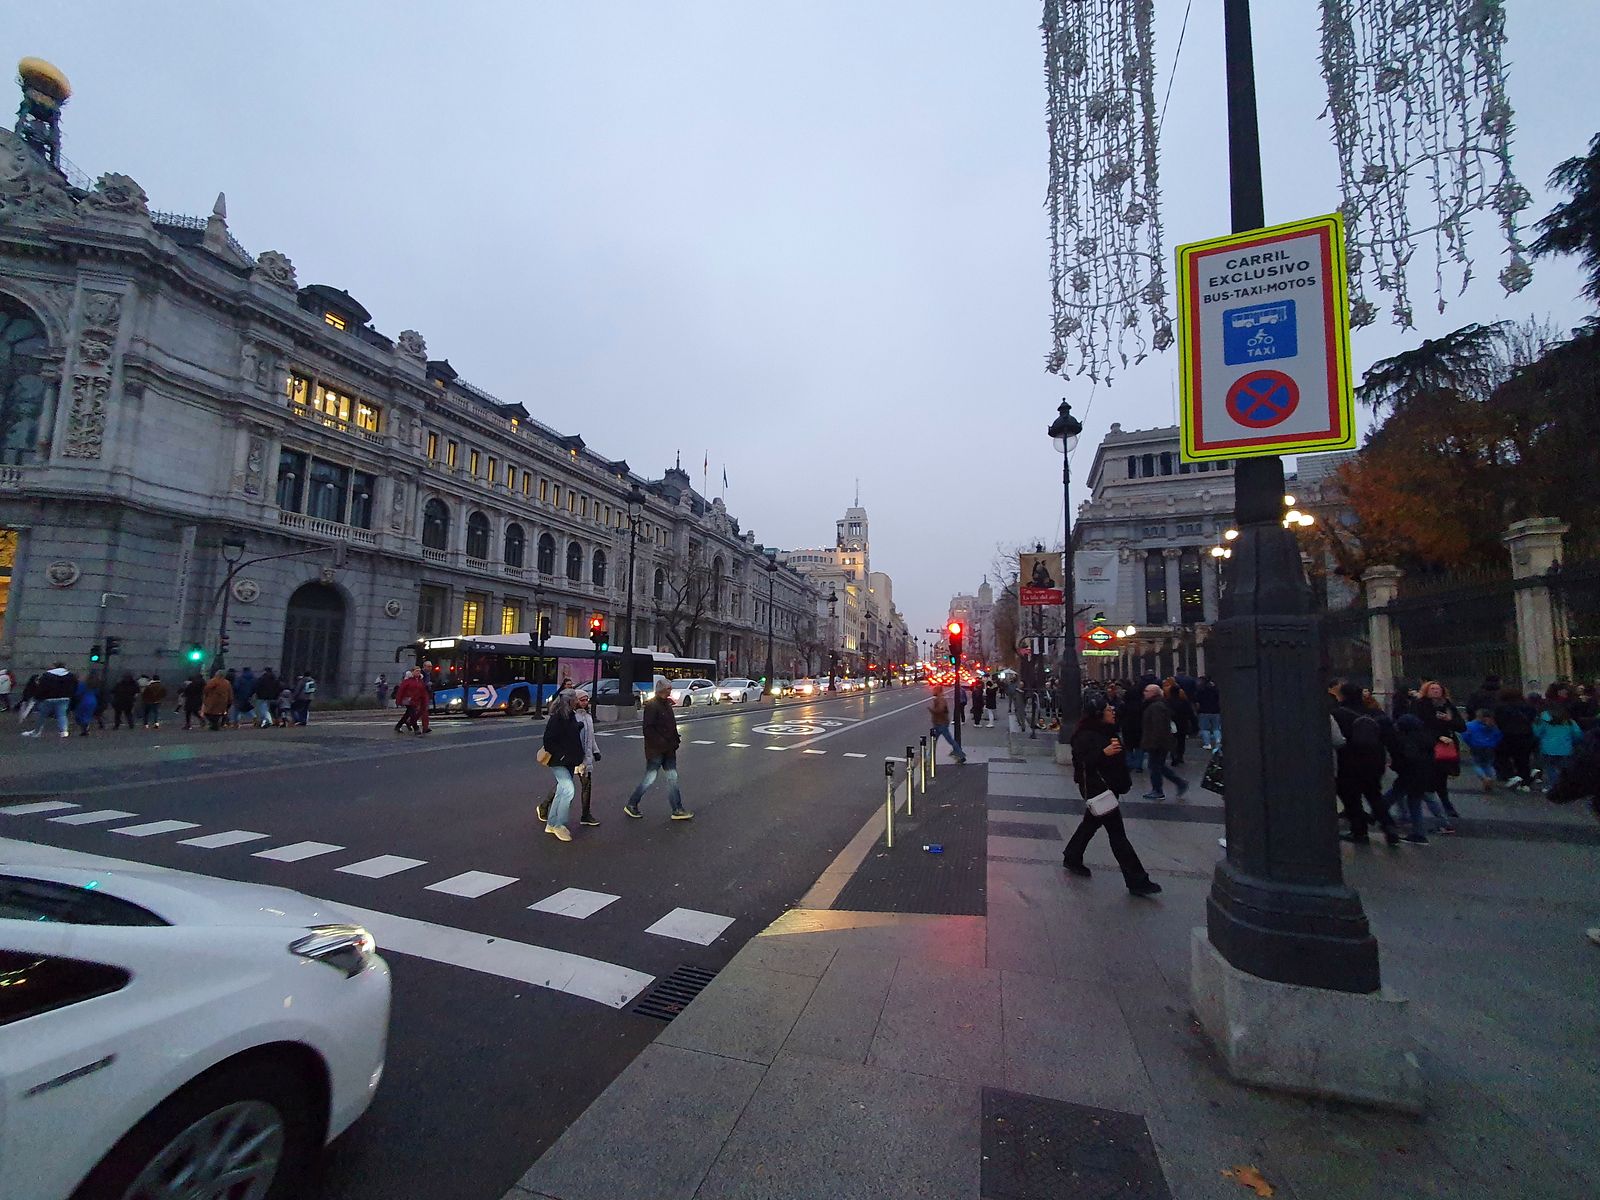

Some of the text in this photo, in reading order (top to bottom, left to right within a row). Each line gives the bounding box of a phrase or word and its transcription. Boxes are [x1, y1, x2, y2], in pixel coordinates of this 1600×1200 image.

[1226, 250, 1290, 270] CARRIL
[1209, 260, 1310, 287] EXCLUSIVO
[1203, 276, 1316, 304] BUS-TAXI-MOTOS
[1247, 346, 1276, 357] TAXI
[424, 640, 430, 650] 2
